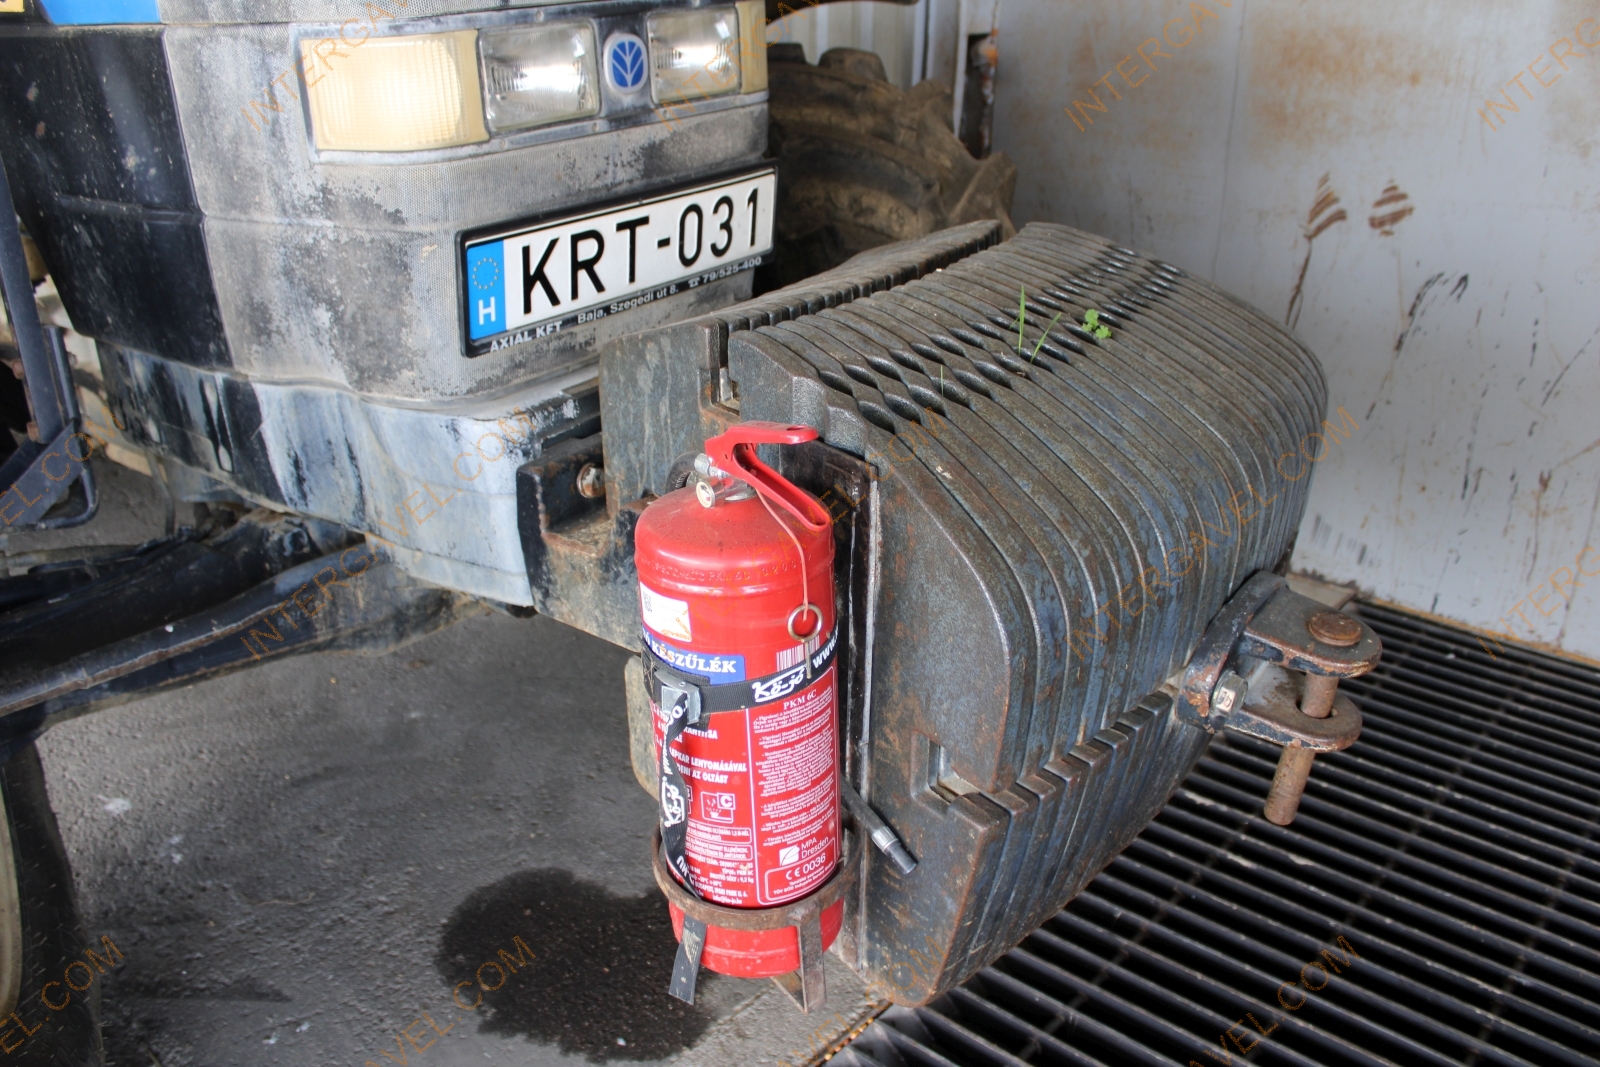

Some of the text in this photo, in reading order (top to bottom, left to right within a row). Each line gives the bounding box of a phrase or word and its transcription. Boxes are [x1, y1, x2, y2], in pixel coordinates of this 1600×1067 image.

[521, 187, 759, 316] KRT-031
[536, 320, 563, 339] KFT
[577, 309, 607, 325] Baja,
[702, 256, 762, 284] 79/525-400
[478, 296, 496, 326] H
[651, 638, 737, 673] KÉSZÜLÉK
[783, 688, 817, 710] PKM 6C
[690, 756, 748, 773] LENYOMÁSÁVAL
[702, 771, 729, 785] OLTÁST
[801, 837, 817, 851] MPA
[801, 837, 829, 859] Dresden
[803, 853, 826, 875] 0036
